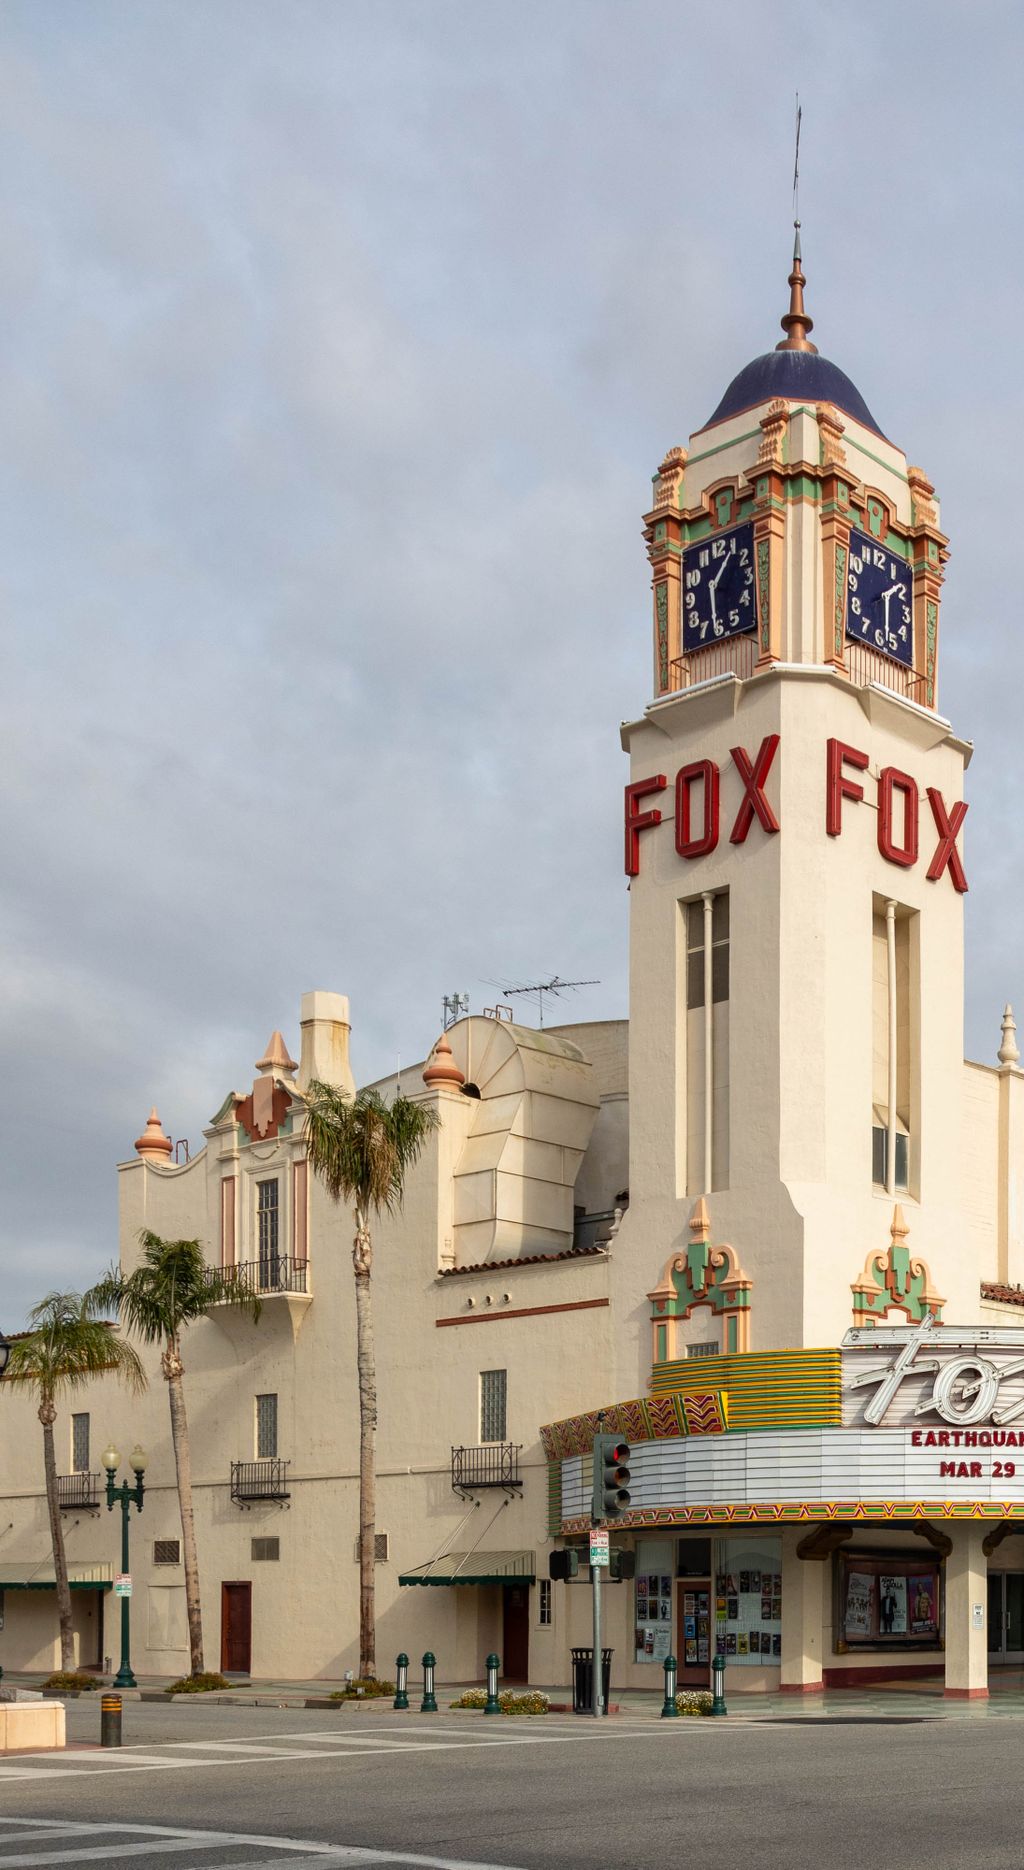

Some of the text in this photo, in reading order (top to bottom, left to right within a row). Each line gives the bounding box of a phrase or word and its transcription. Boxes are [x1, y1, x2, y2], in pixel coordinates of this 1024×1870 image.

[712, 539, 726, 559] 12
[730, 538, 736, 554] 1
[862, 545, 870, 565] 11
[699, 549, 709, 568] 11
[740, 548, 749, 567] 2
[849, 552, 863, 574] 10
[873, 549, 885, 571] 12
[686, 569, 700, 589] 10
[744, 567, 753, 585] 3
[890, 563, 896, 580] 1
[848, 574, 858, 592] 9
[898, 583, 907, 601] 2
[686, 592, 695, 609] 9
[739, 589, 750, 607] 4
[851, 597, 861, 615] 8
[688, 611, 699, 628] 8
[728, 609, 739, 627] 5
[902, 605, 911, 624] 3
[700, 620, 709, 639] 7
[714, 619, 724, 637] 6
[861, 617, 871, 634] 7
[898, 625, 907, 642] 4
[874, 629, 884, 647] 6
[889, 633, 898, 651] 5
[624, 733, 781, 877] FOX
[826, 737, 969, 893] FOX
[939, 1461, 1016, 1479] MAR 29
